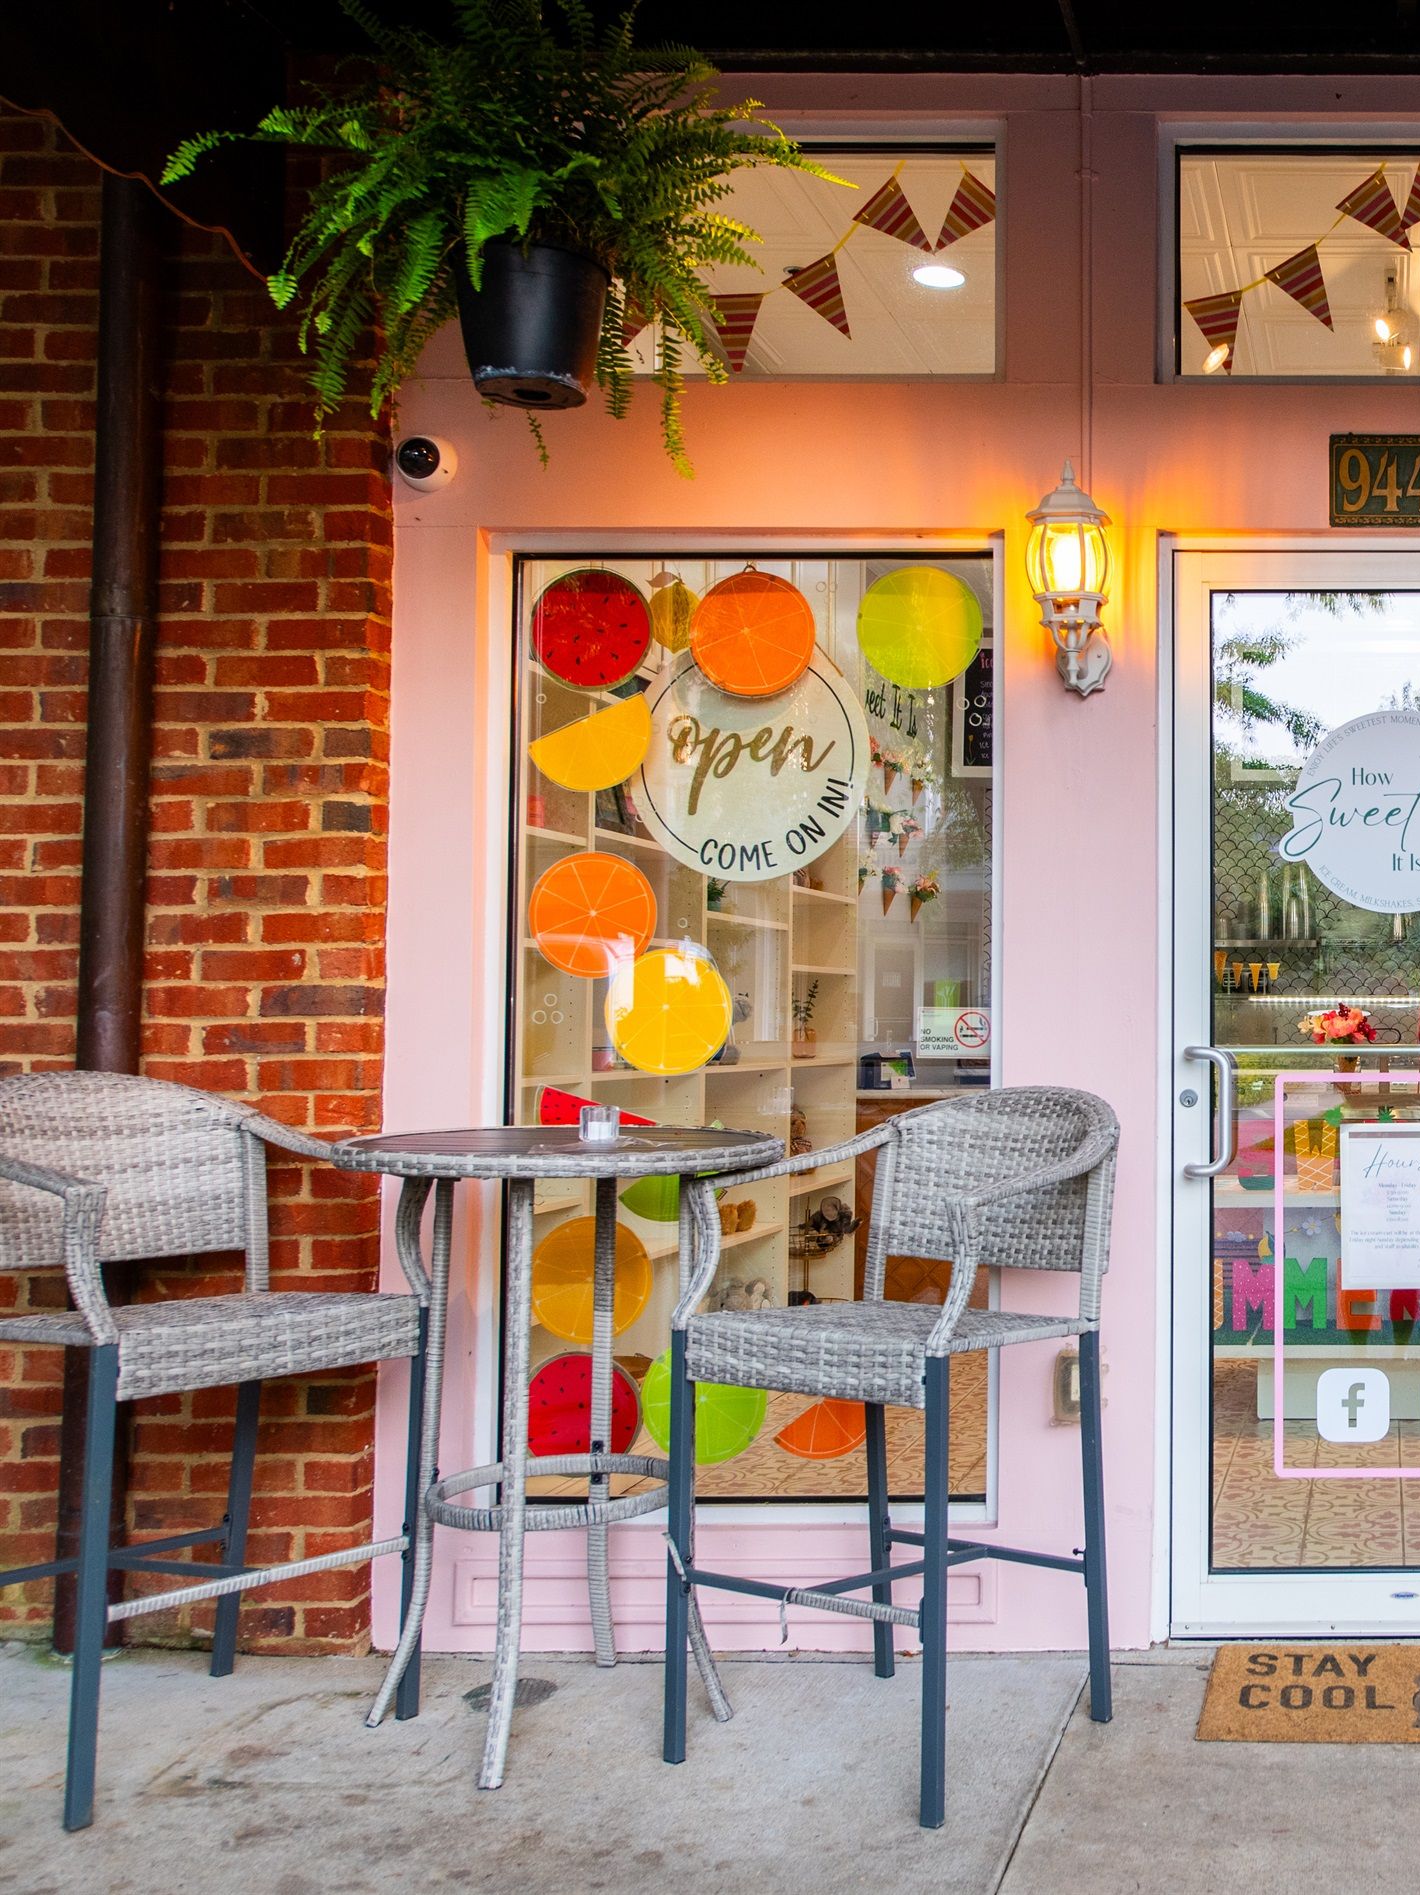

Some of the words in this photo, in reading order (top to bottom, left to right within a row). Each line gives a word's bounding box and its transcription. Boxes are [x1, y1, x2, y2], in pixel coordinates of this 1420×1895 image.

[1306, 753, 1324, 776] ENJOY
[1344, 716, 1387, 736] SWEETEST
[1352, 767, 1394, 786] How
[700, 838, 778, 872] COME
[786, 815, 826, 855] ON
[817, 778, 854, 819] IN!
[1318, 864, 1330, 878] ICE
[1392, 853, 1403, 871] It
[1341, 1382, 1366, 1428] f
[1246, 1652, 1378, 1678] STAY
[1238, 1683, 1396, 1710] COOL
